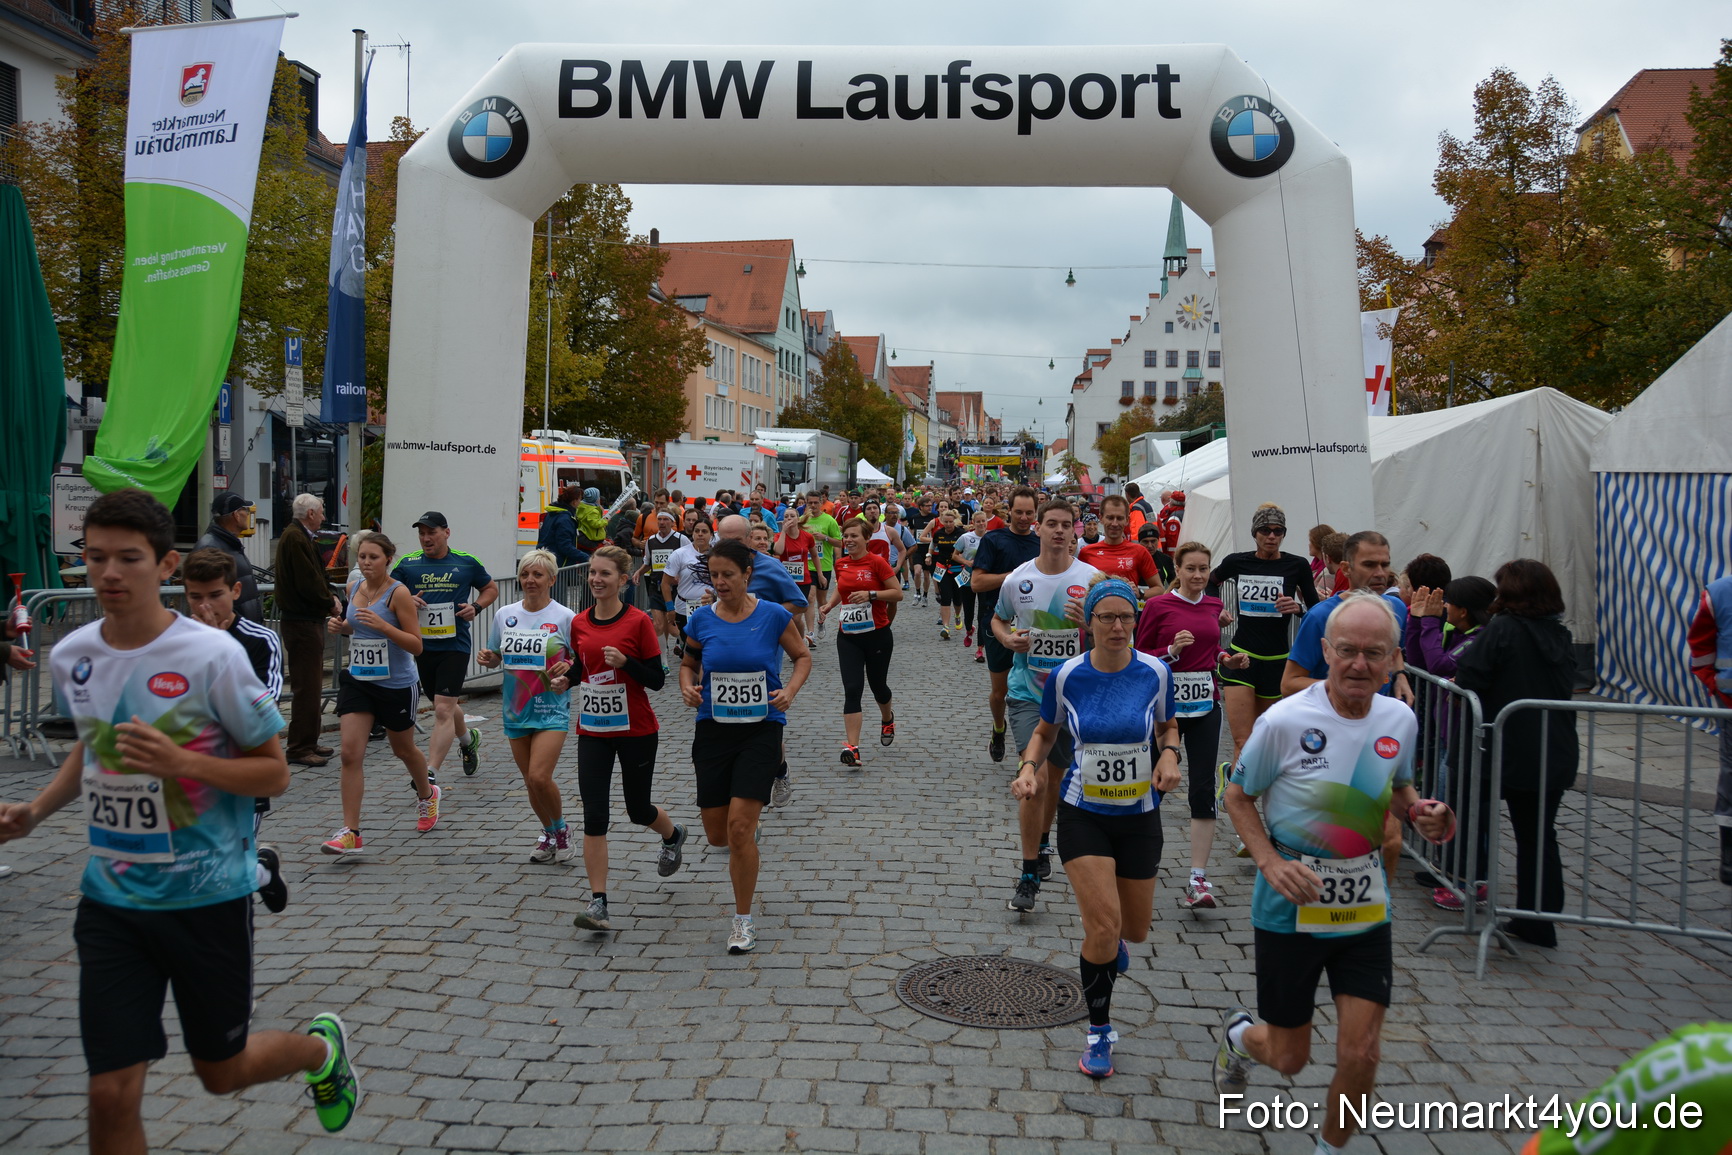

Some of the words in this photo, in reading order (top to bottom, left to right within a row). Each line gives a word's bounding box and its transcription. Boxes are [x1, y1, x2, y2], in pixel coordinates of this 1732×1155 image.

[558, 59, 775, 119] BMW
[796, 59, 1182, 136] Laufsport
[458, 98, 522, 124] BMW
[1218, 96, 1286, 123] BMW
[336, 381, 366, 396] railon
[222, 388, 228, 418] P
[387, 440, 496, 454] www.bmw-laufsport.de
[1252, 442, 1368, 458] www.bmw-laufsport.de
[56, 483, 94, 492] Fußgänger
[421, 572, 452, 584] Blond!
[1242, 585, 1279, 601] 2249
[428, 612, 443, 626] 21
[843, 609, 869, 622] 2461
[504, 638, 542, 653] 2646
[1033, 638, 1076, 656] 2356
[354, 649, 383, 665] 2191
[717, 684, 762, 704] 2359
[1174, 684, 1210, 700] 2305
[583, 694, 623, 714] 2555
[1108, 748, 1140, 757] Neumarkt
[1096, 757, 1137, 783] 381
[1100, 787, 1137, 797] Melanie
[90, 792, 158, 829] 2579
[1336, 863, 1372, 874] Neumarkt
[1319, 875, 1372, 904] 332
[1330, 910, 1357, 922] Willi
